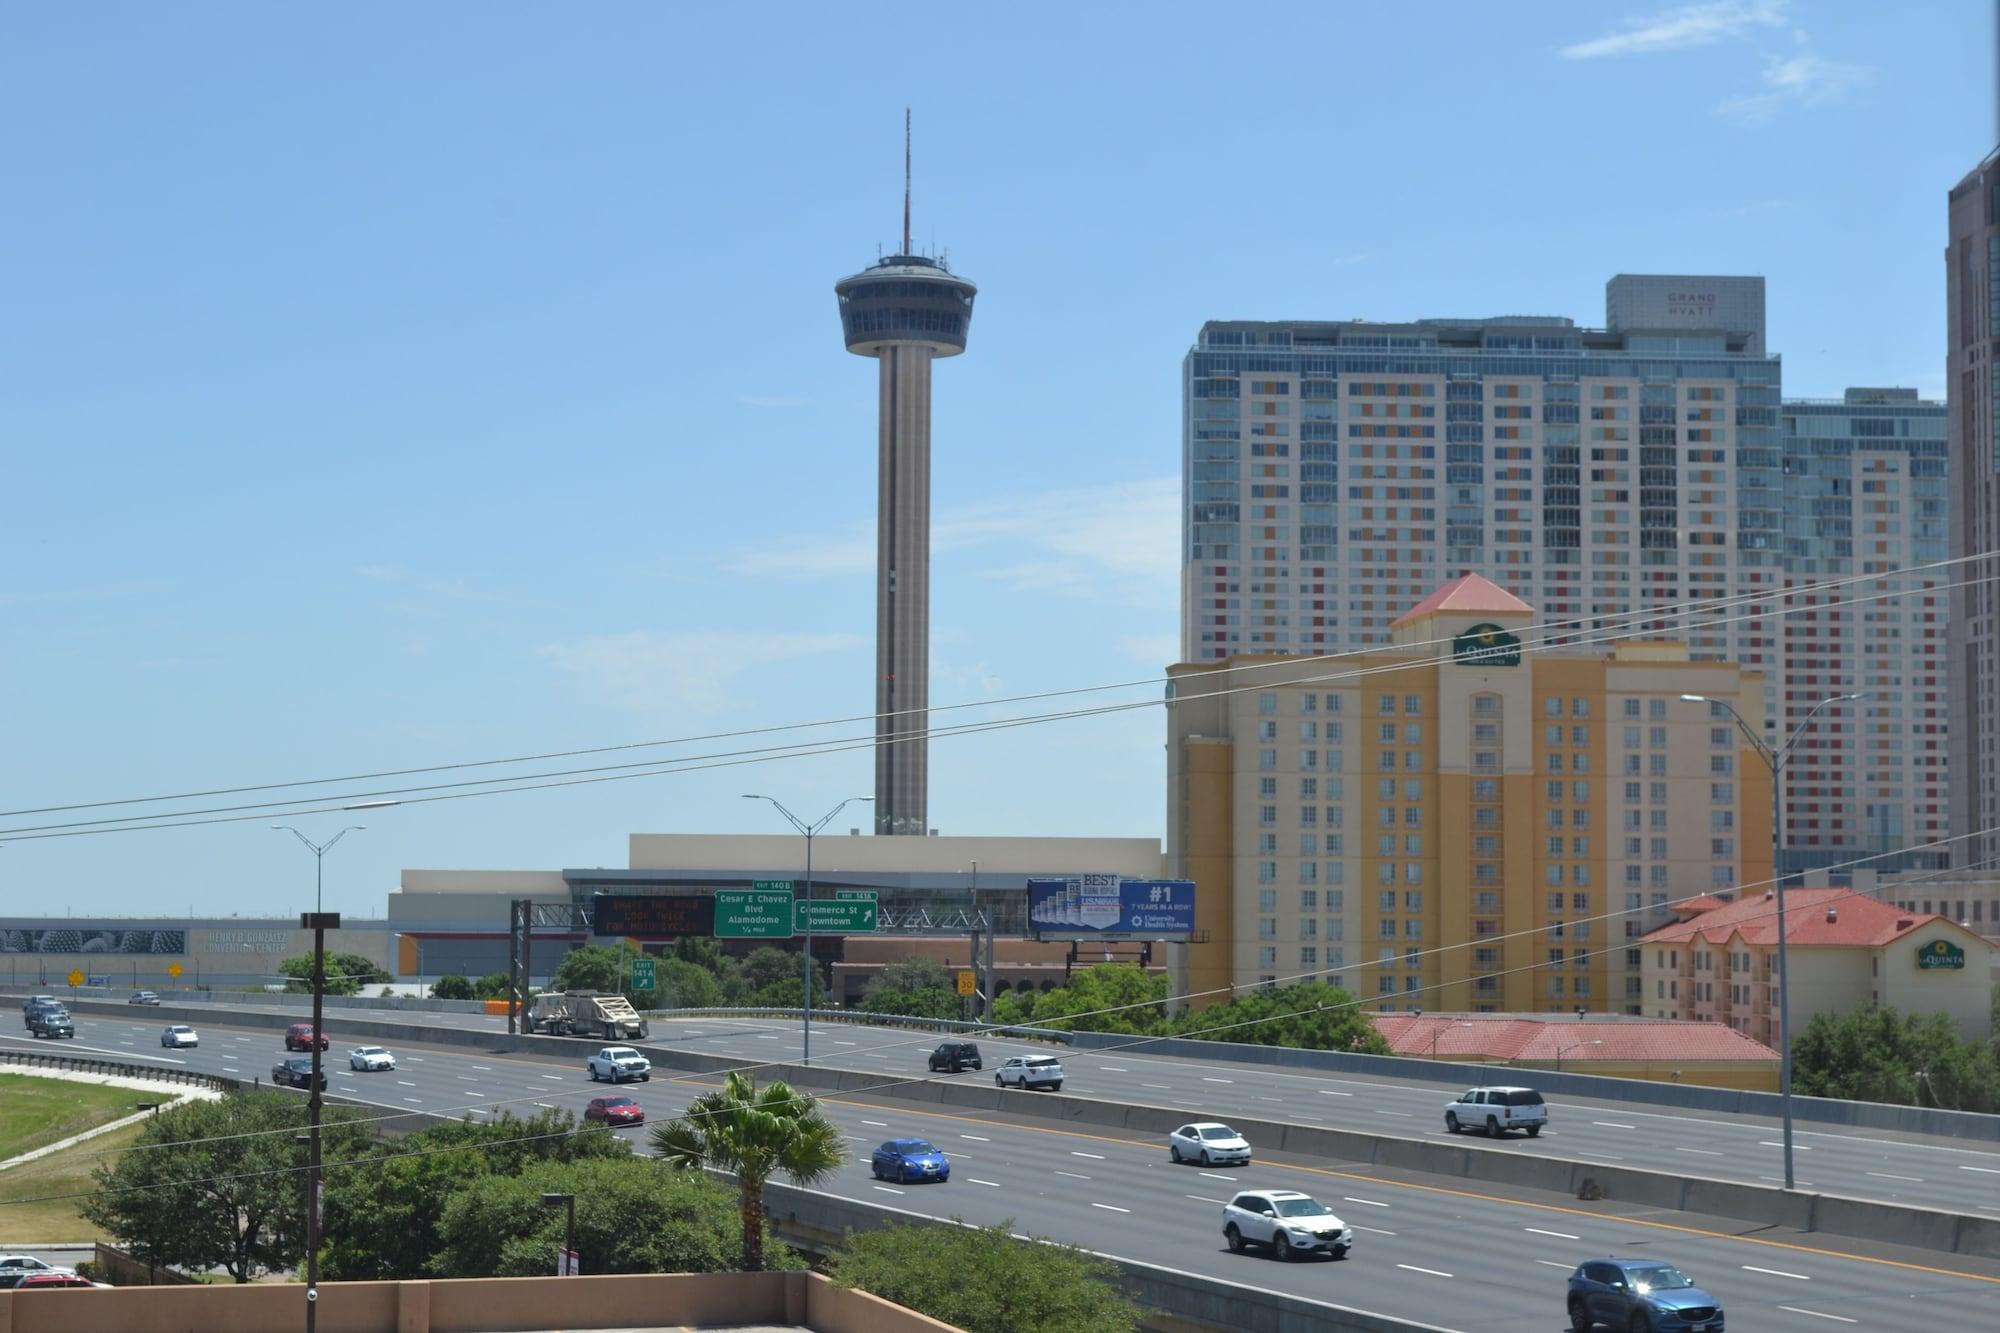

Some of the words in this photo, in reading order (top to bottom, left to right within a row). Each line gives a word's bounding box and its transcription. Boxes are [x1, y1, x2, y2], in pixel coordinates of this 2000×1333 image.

[1668, 292, 1714, 302] GRAND
[1669, 306, 1712, 316] HYATT
[1466, 645, 1519, 658] QUINTA
[1083, 874, 1117, 886] BEST
[720, 895, 744, 903] Cesar
[748, 895, 753, 903] E
[757, 895, 788, 903] Chavez
[1149, 886, 1171, 903] #1
[744, 905, 764, 913] Blvd
[848, 906, 858, 914] St
[728, 915, 780, 924] Alamodome
[209, 931, 235, 942] HENRY
[203, 943, 254, 953] CONVENTION
[256, 943, 286, 953] CENTER
[1926, 955, 1963, 965] QUINTA
[961, 980, 973, 989] 30
